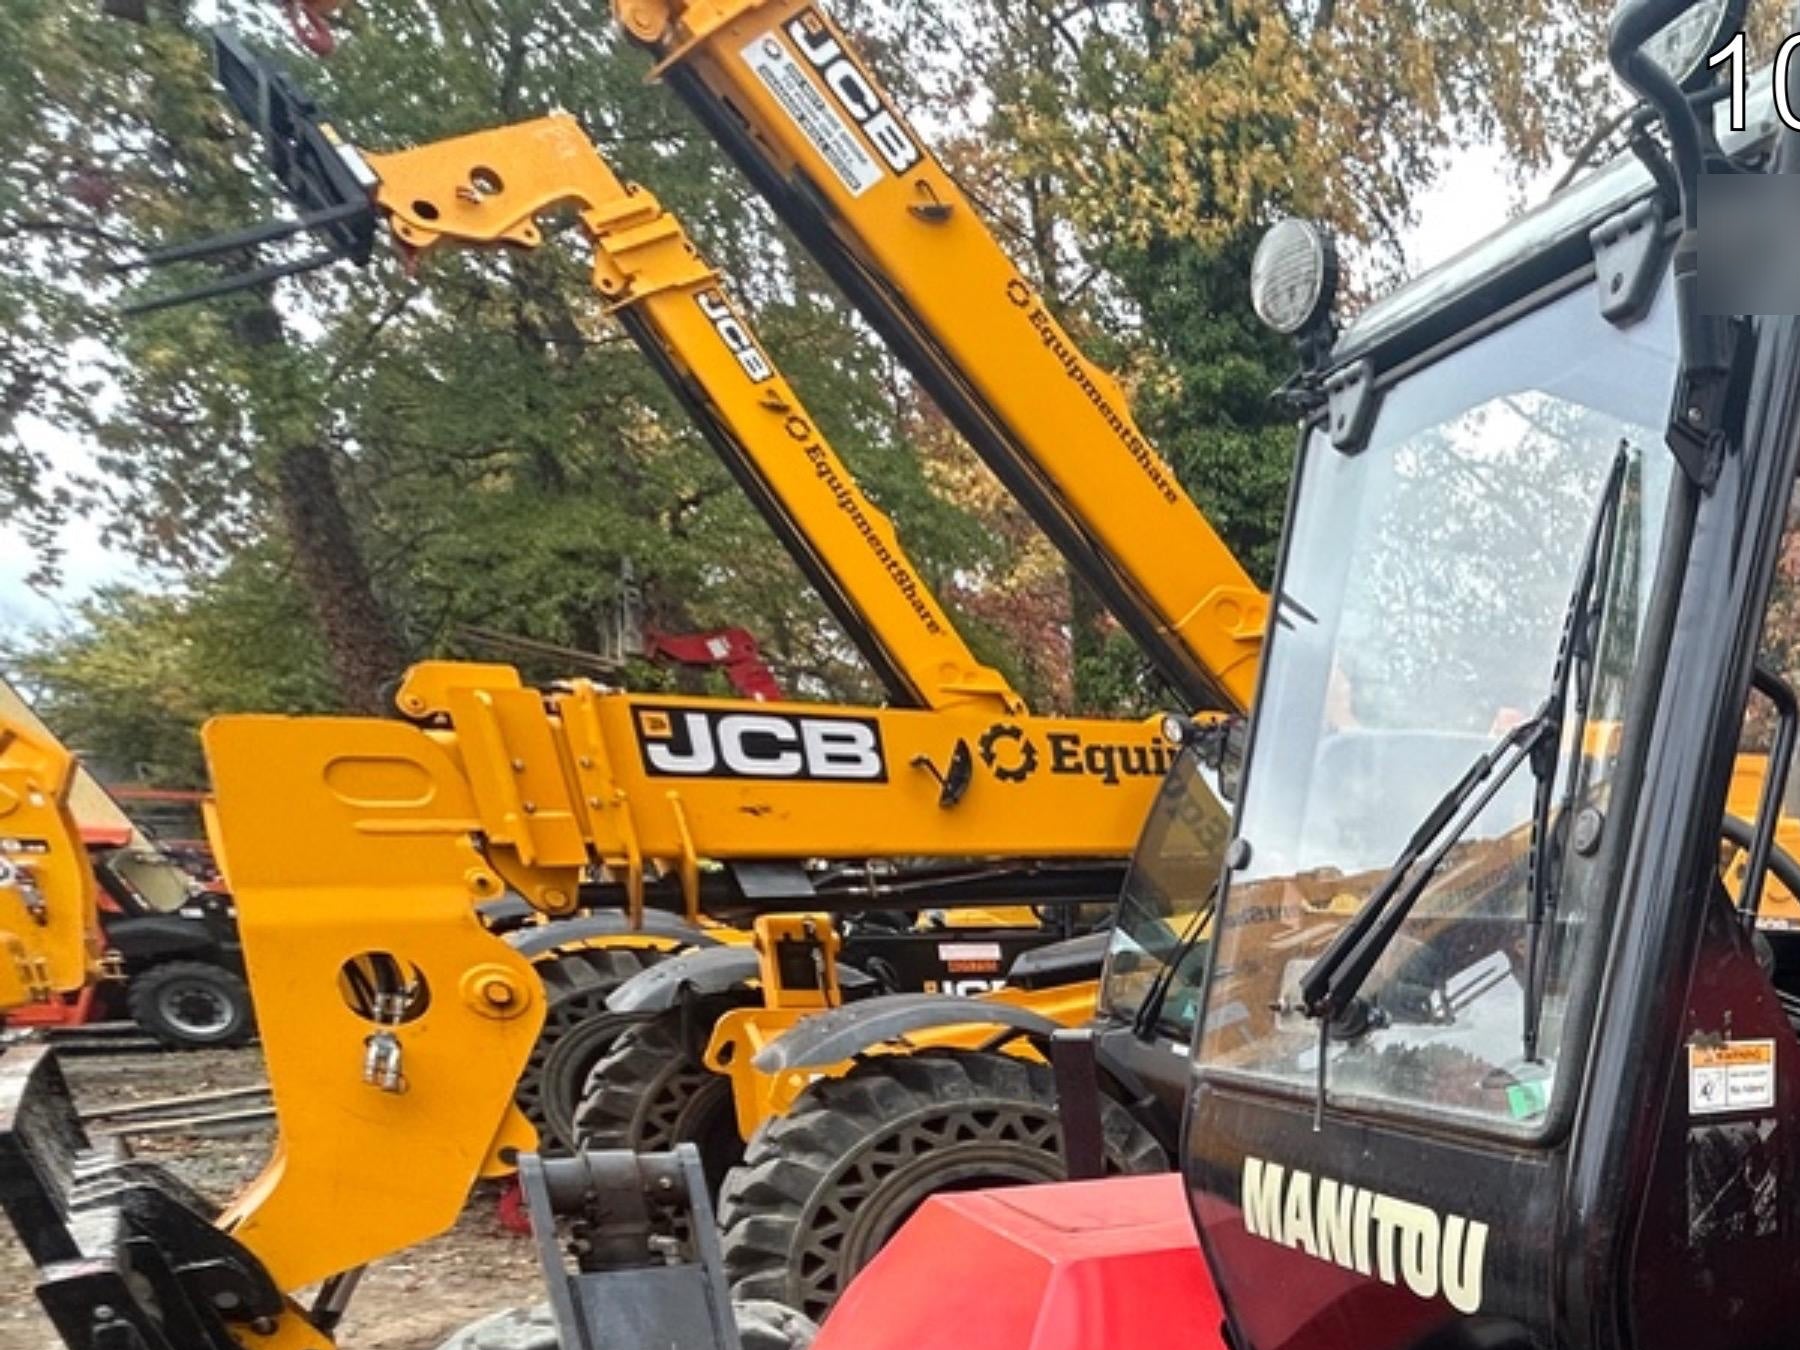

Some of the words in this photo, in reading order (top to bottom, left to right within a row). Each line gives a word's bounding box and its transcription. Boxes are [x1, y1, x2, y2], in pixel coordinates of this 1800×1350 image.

[789, 20, 918, 171] JCB
[698, 292, 771, 382] JCB
[1028, 309, 1178, 505] EquipmentShare
[803, 445, 942, 637] EquipmentShare
[645, 714, 881, 779] JCB
[1242, 1157, 1489, 1314] MANITOU
